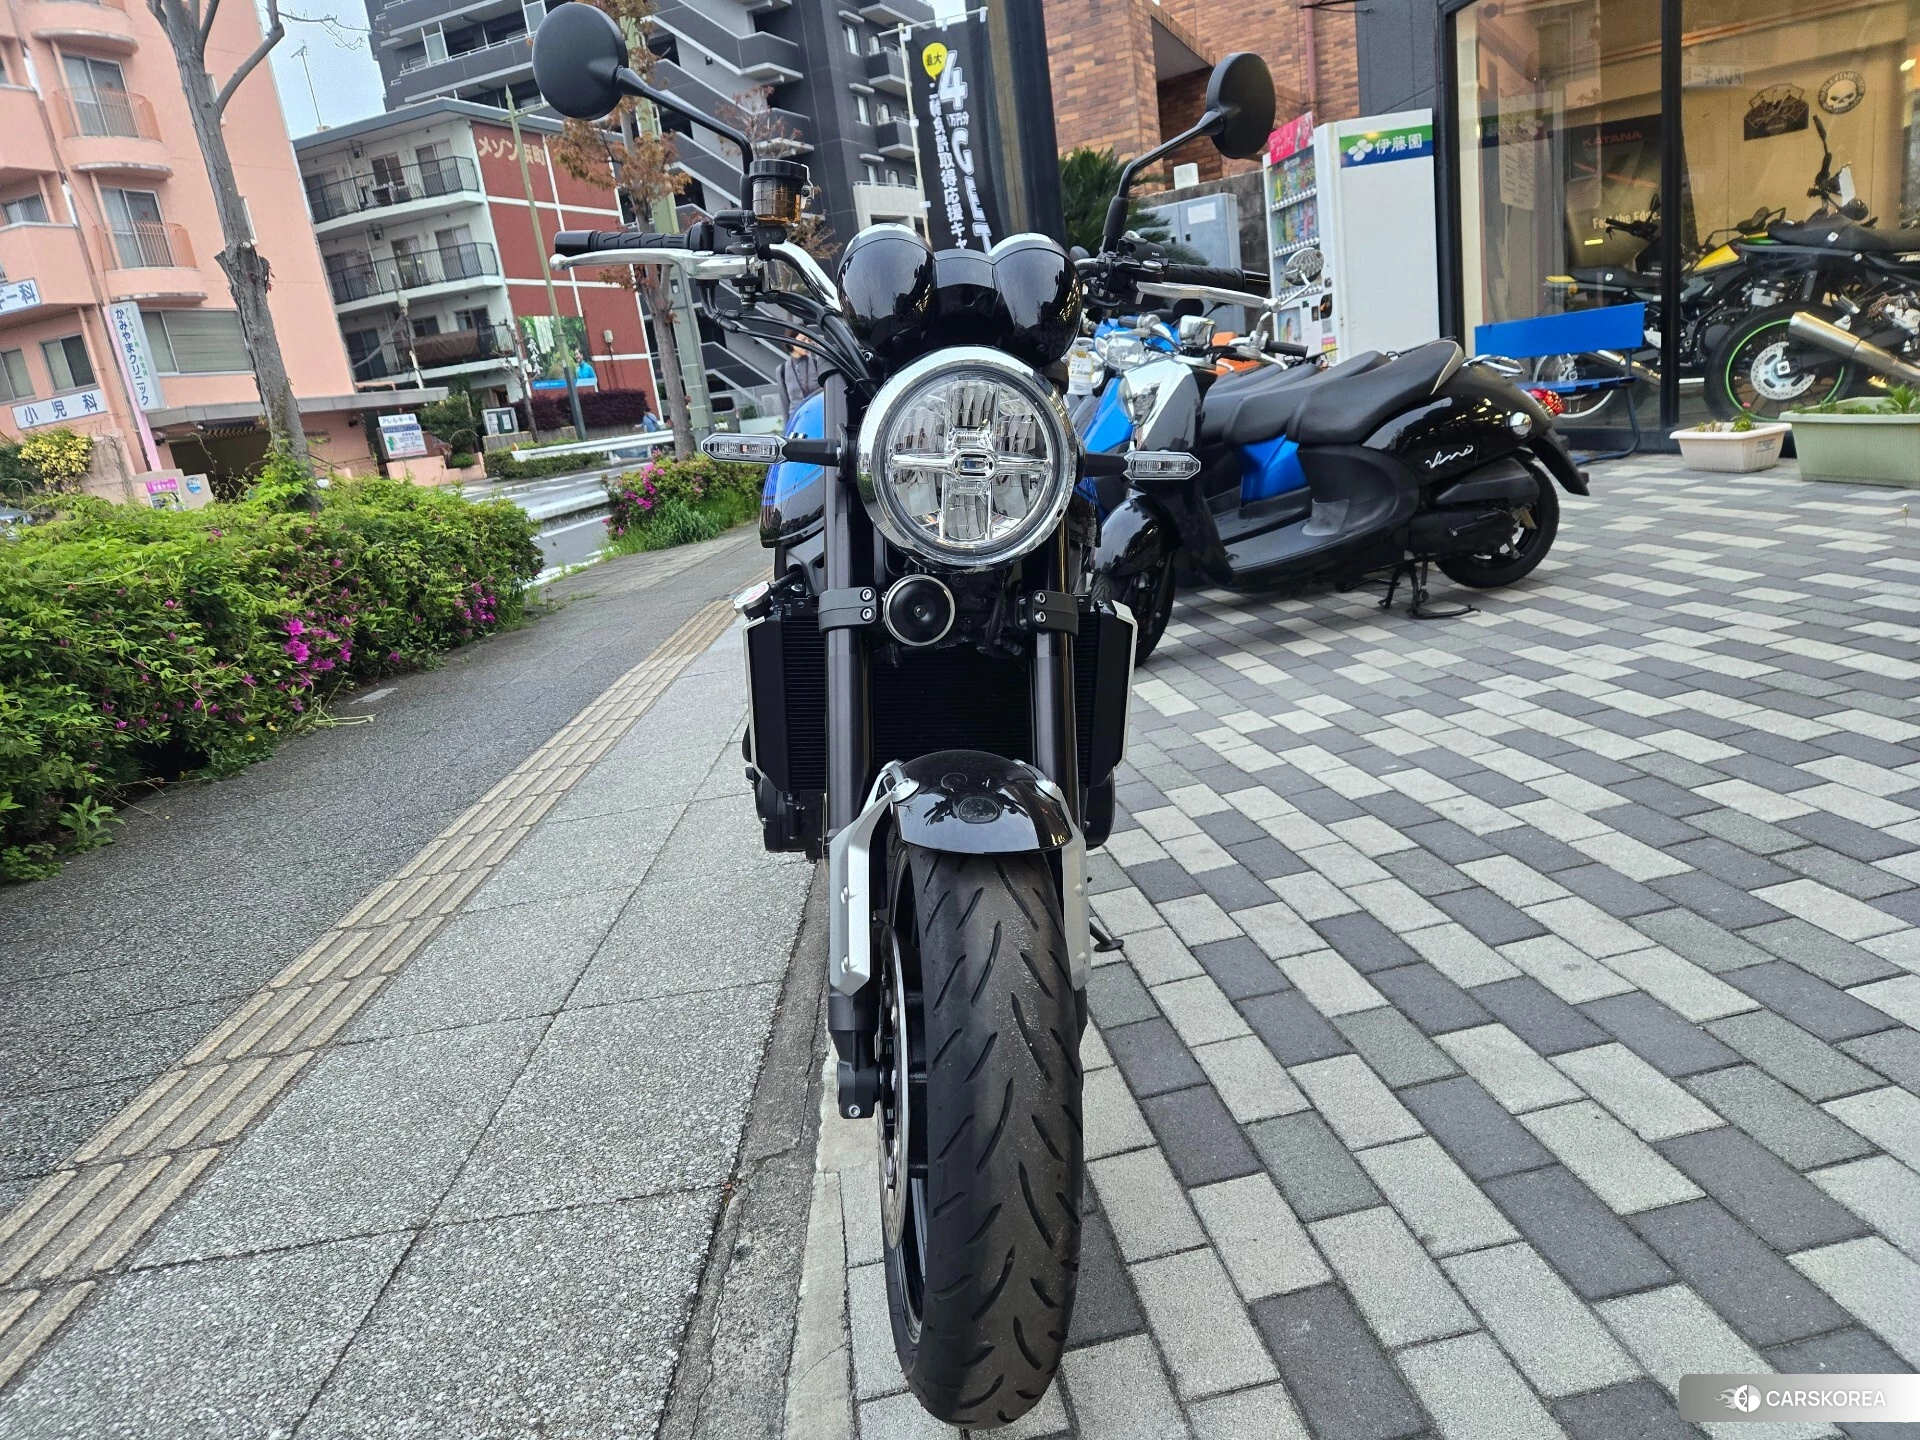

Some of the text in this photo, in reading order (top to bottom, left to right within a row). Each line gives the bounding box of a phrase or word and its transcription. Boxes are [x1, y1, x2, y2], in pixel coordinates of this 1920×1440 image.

[939, 50, 968, 110] 4
[1375, 133, 1422, 155] 伊藤園
[1583, 130, 1643, 147] KATANA
[115, 308, 149, 405] かみやまクリニック
[24, 392, 99, 425] 小児科
